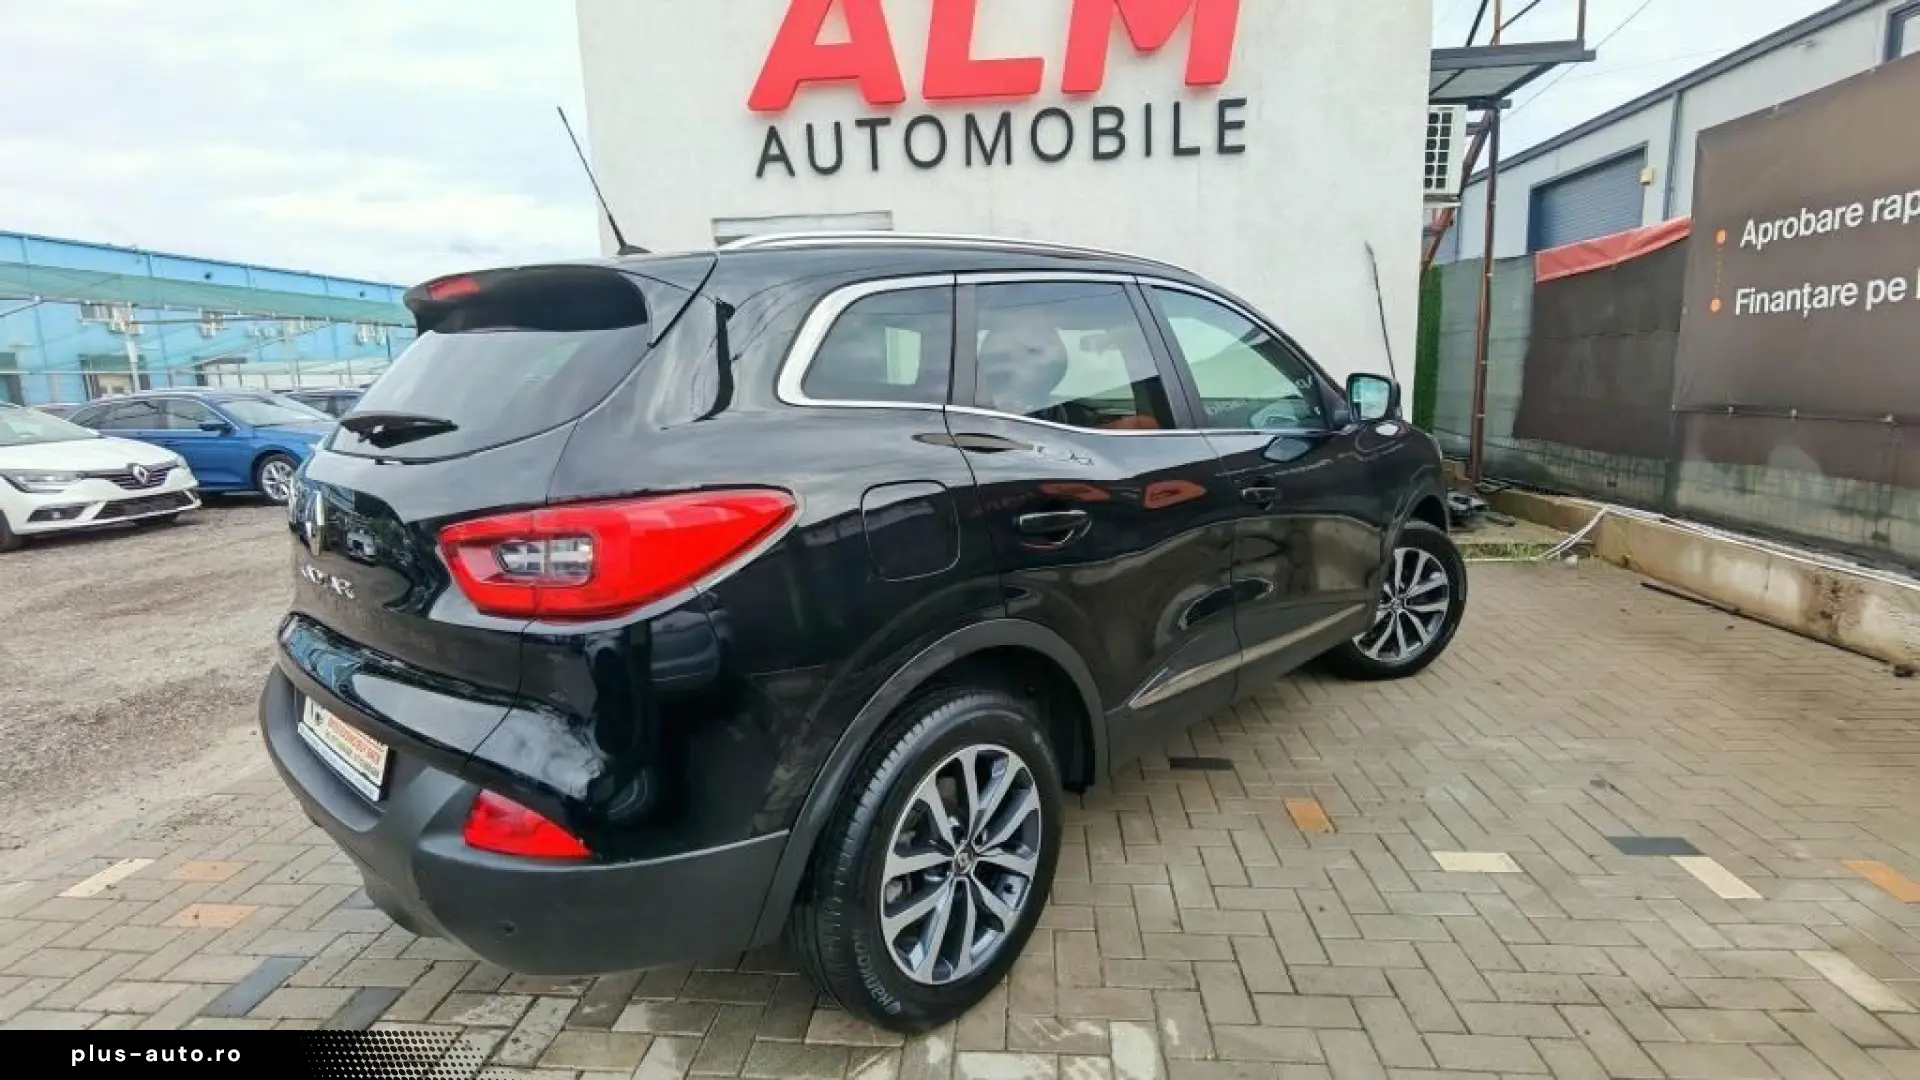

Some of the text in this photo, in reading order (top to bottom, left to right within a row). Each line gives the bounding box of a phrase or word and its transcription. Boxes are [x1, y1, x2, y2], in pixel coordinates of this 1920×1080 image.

[748, 0, 1240, 111] ALM
[756, 98, 1247, 178] AUTOMOBILE
[1740, 201, 1864, 250] Aprobare
[1735, 281, 1859, 318] Finanțare
[1865, 275, 1908, 312] pe
